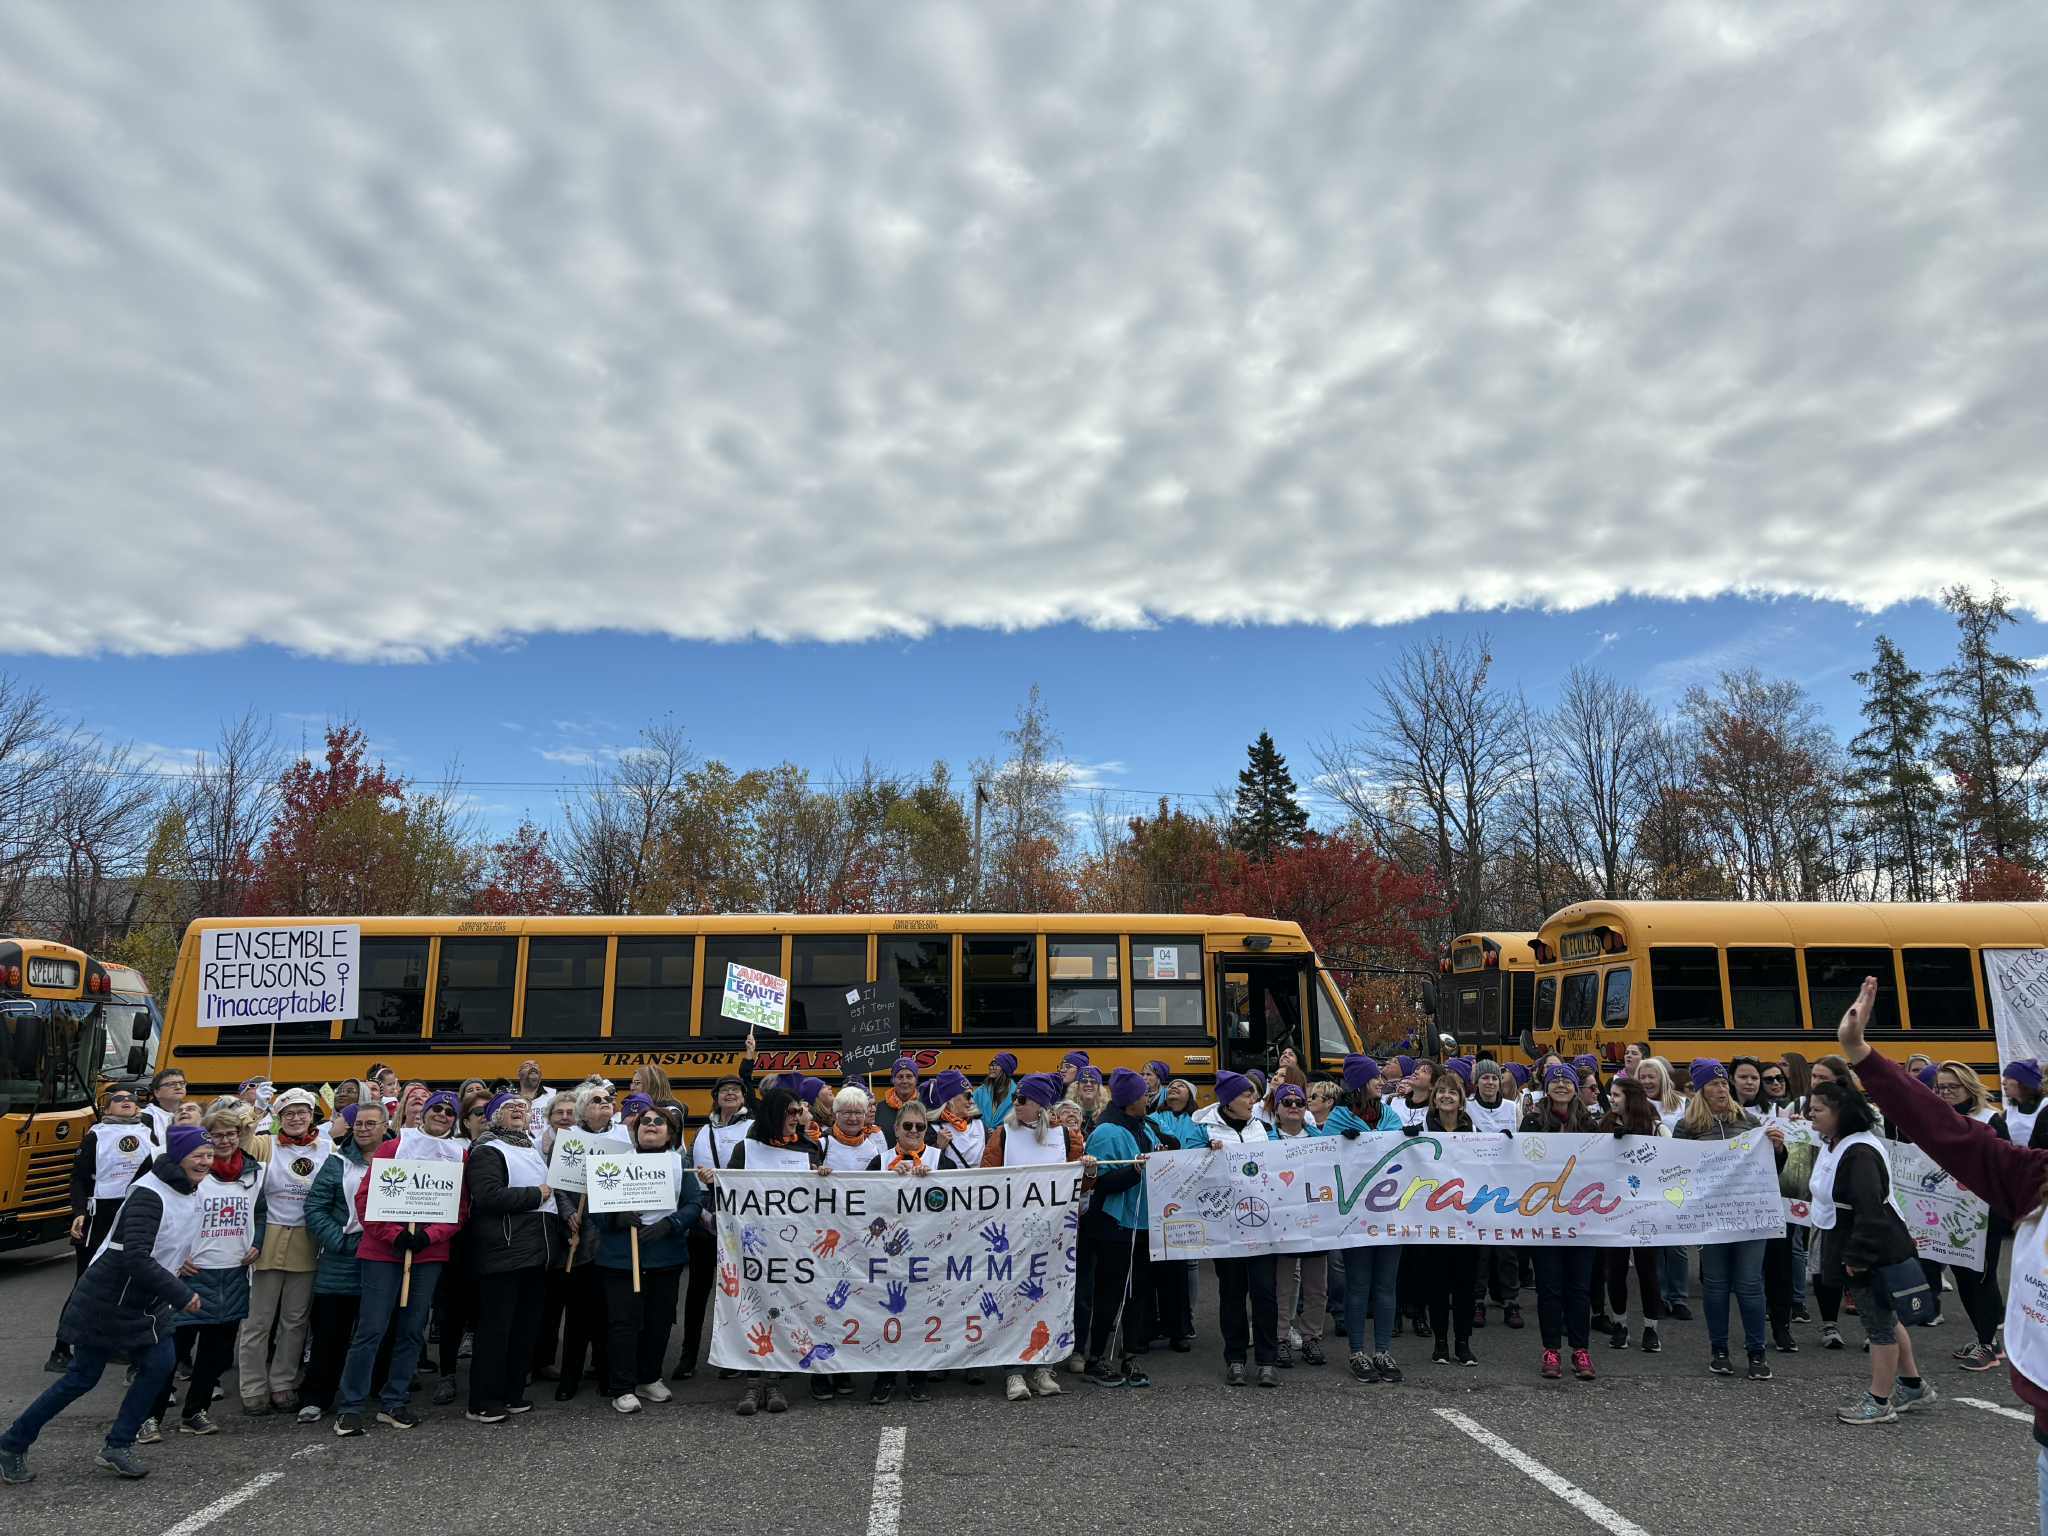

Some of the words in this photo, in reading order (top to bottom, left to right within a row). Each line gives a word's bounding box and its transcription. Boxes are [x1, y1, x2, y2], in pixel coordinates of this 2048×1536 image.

[216, 930, 348, 961] ENSEMBLE
[1159, 949, 1171, 960] 04
[32, 960, 65, 985] SPECIAL
[204, 961, 326, 991] REFUSONS
[206, 987, 345, 1021] l'inacceptable!
[602, 1052, 739, 1066] TRANSPORT
[408, 1172, 454, 1191] Afeas
[623, 1165, 666, 1181] Afeas
[1333, 1136, 1622, 1216] Véranda
[203, 1196, 249, 1212] CENTRE
[716, 1187, 866, 1216] MARCHE
[202, 1211, 249, 1229] FEMMES
[1367, 1223, 1456, 1240] CENTRE
[1478, 1226, 1577, 1241] FEMMES
[743, 1256, 815, 1285] DES
[868, 1246, 1076, 1285] FEMMES
[841, 1315, 984, 1345] 2025
